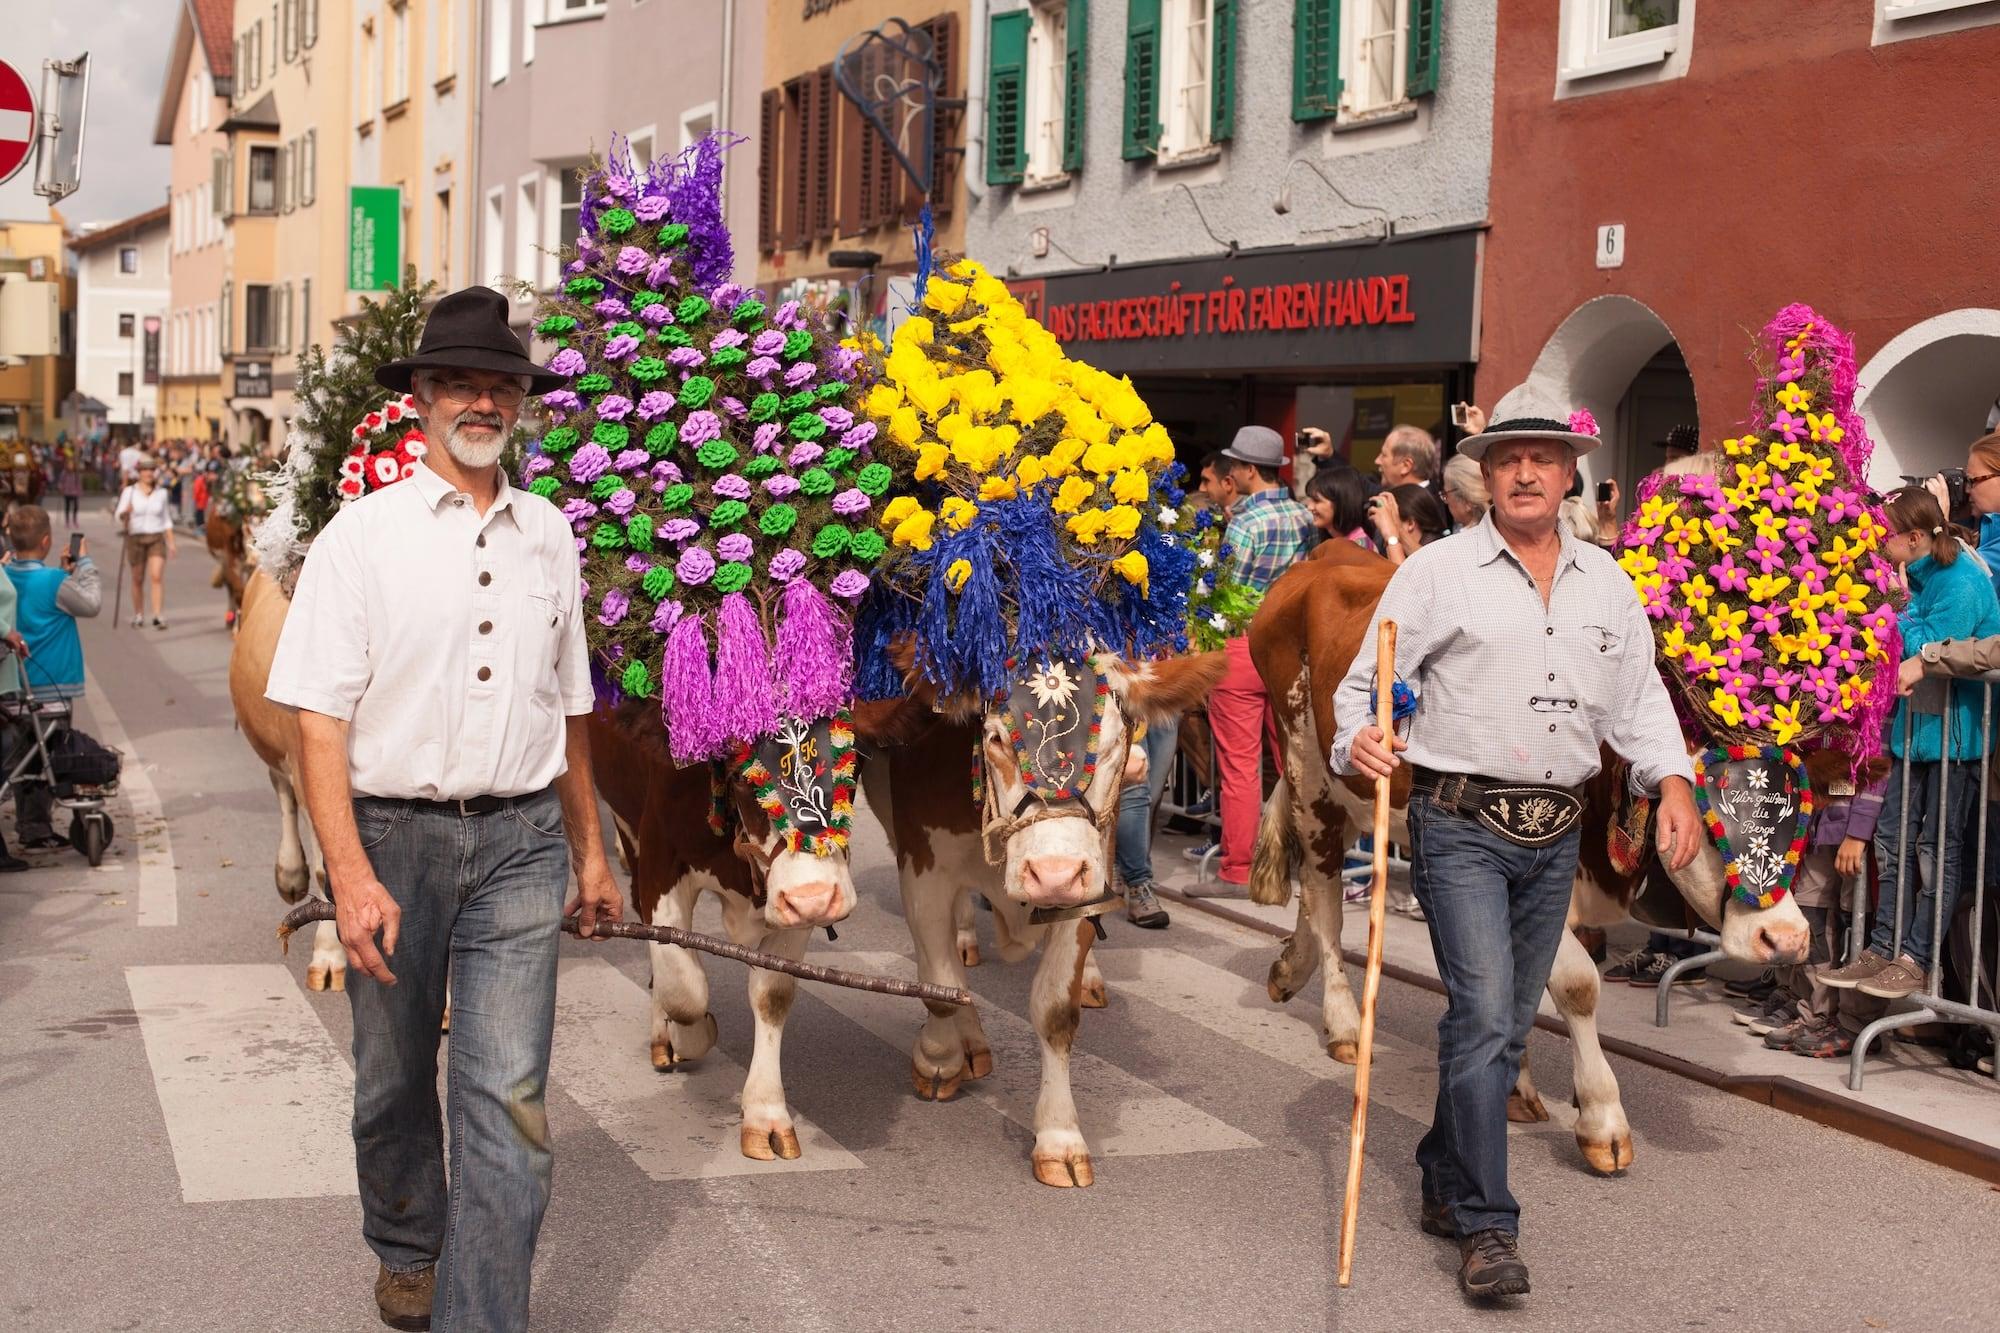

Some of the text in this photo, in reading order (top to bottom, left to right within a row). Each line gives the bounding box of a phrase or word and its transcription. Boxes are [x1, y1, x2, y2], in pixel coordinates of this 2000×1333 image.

[1606, 227, 1615, 254] 6
[1078, 281, 1206, 341] FACHGESCHÄFT
[1207, 275, 1245, 333] FÜR
[1324, 274, 1415, 327] HANDEL
[1730, 790, 1753, 803] Wir
[1752, 807, 1769, 818] die
[1740, 820, 1775, 837] Berge
